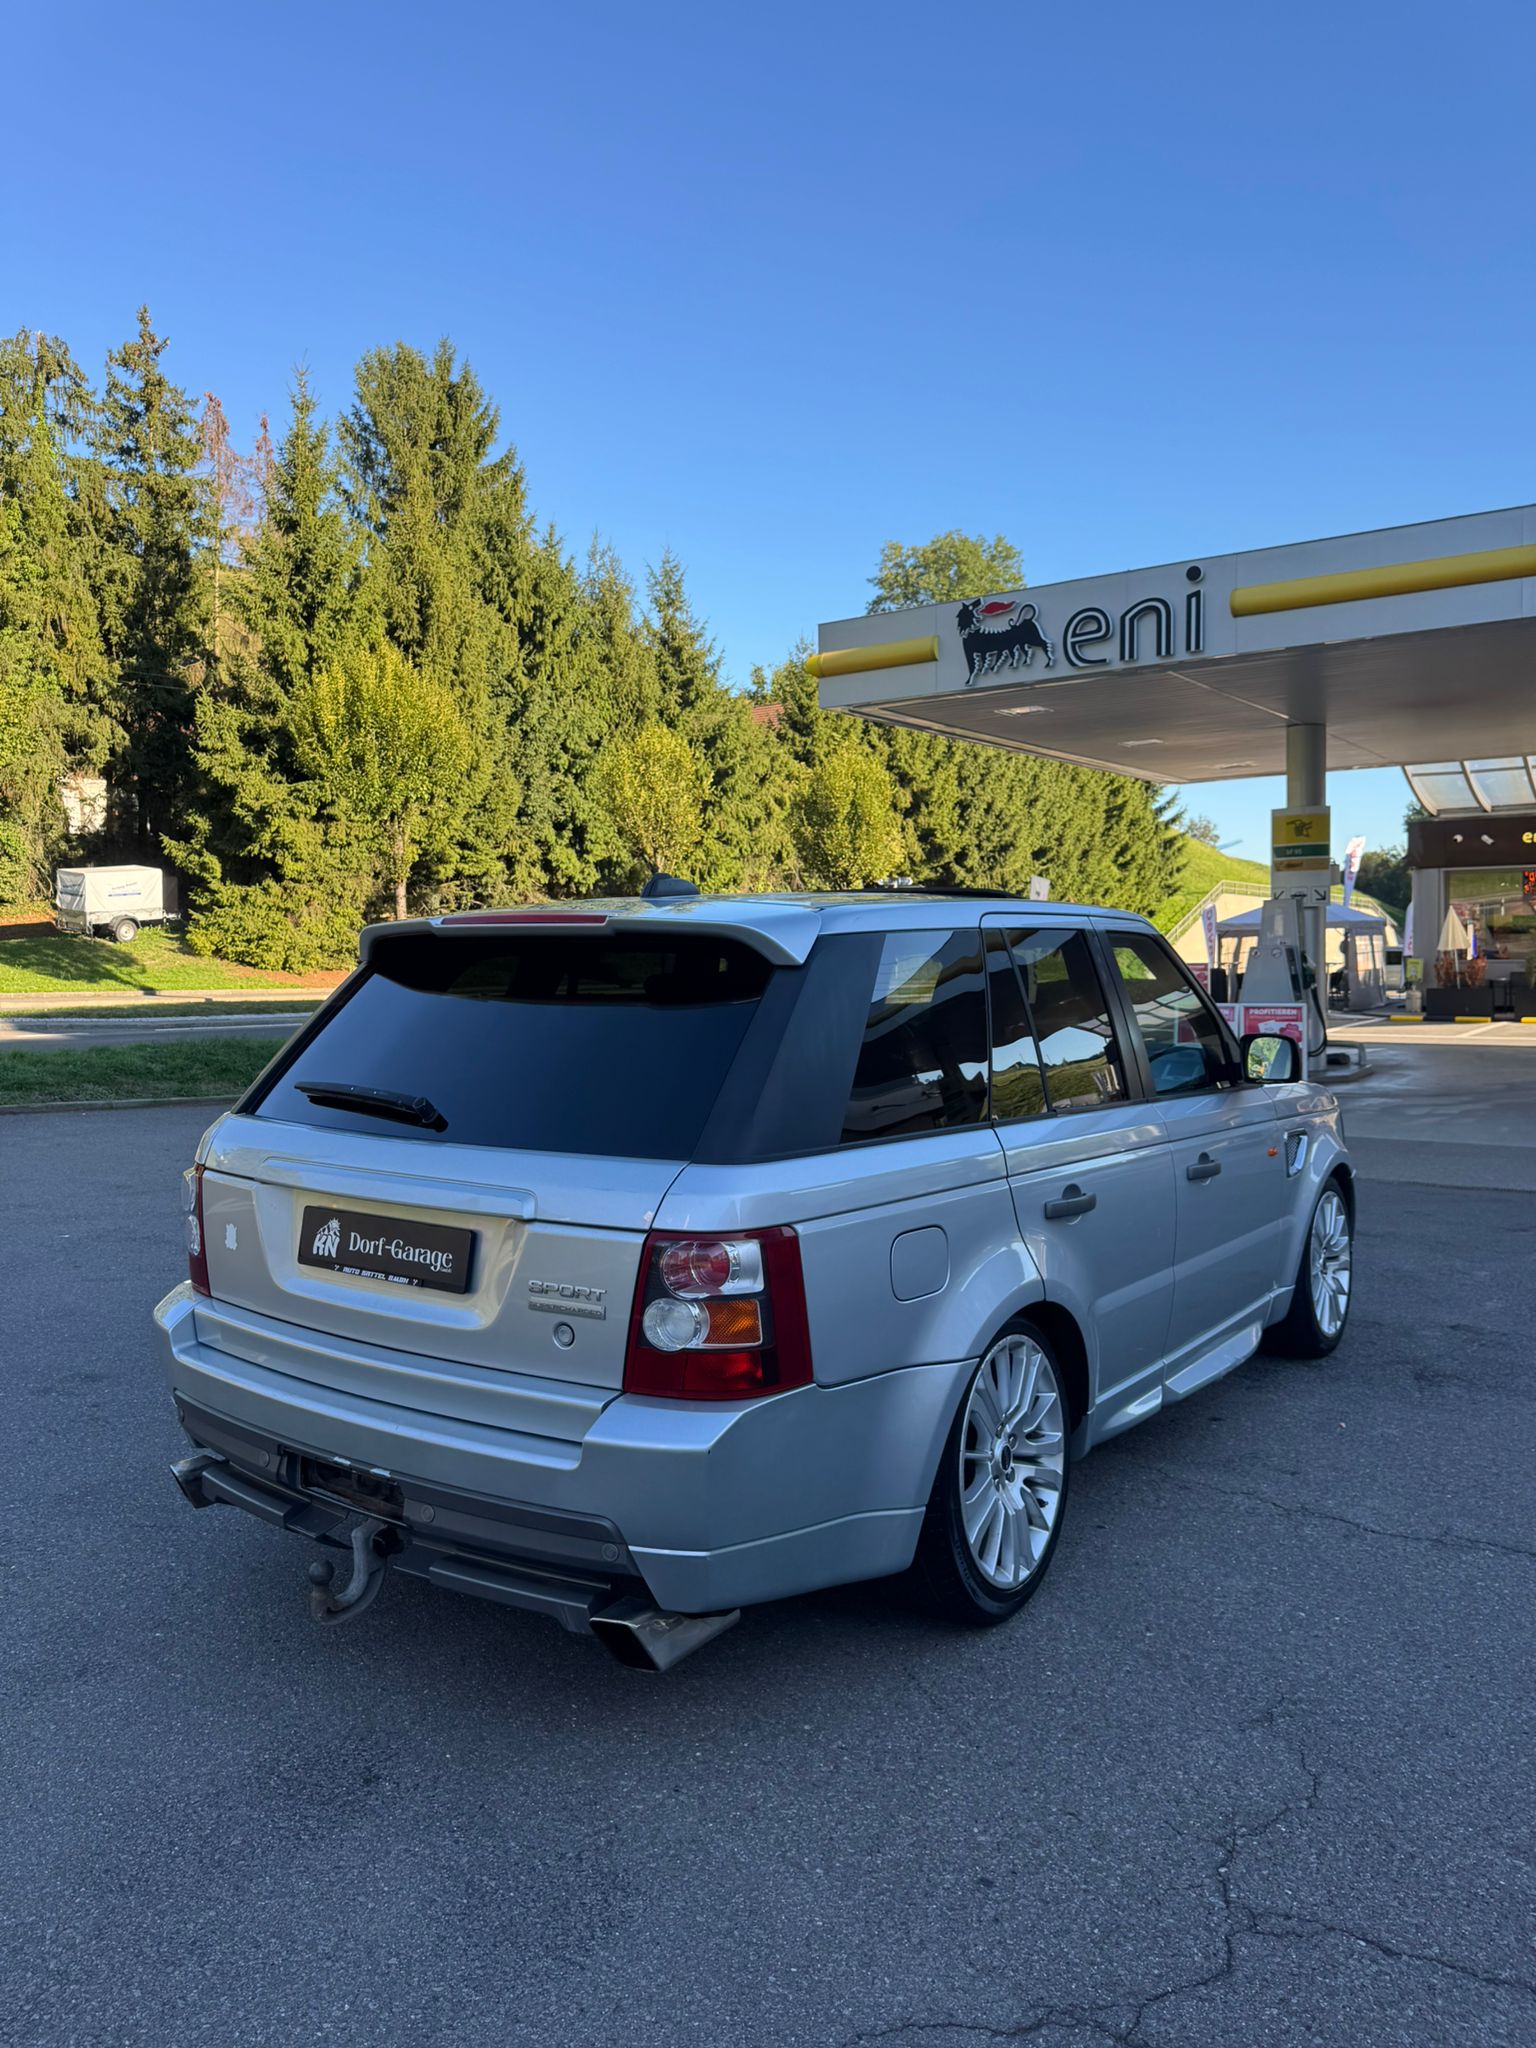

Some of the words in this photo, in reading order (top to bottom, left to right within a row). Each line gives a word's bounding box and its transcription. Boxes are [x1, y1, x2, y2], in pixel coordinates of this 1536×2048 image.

[1063, 564, 1206, 668] eni
[1521, 831, 1536, 844] e
[348, 1231, 454, 1273] Dorf-Garage
[342, 1266, 361, 1275] AUTO
[528, 1279, 607, 1302] SPORT
